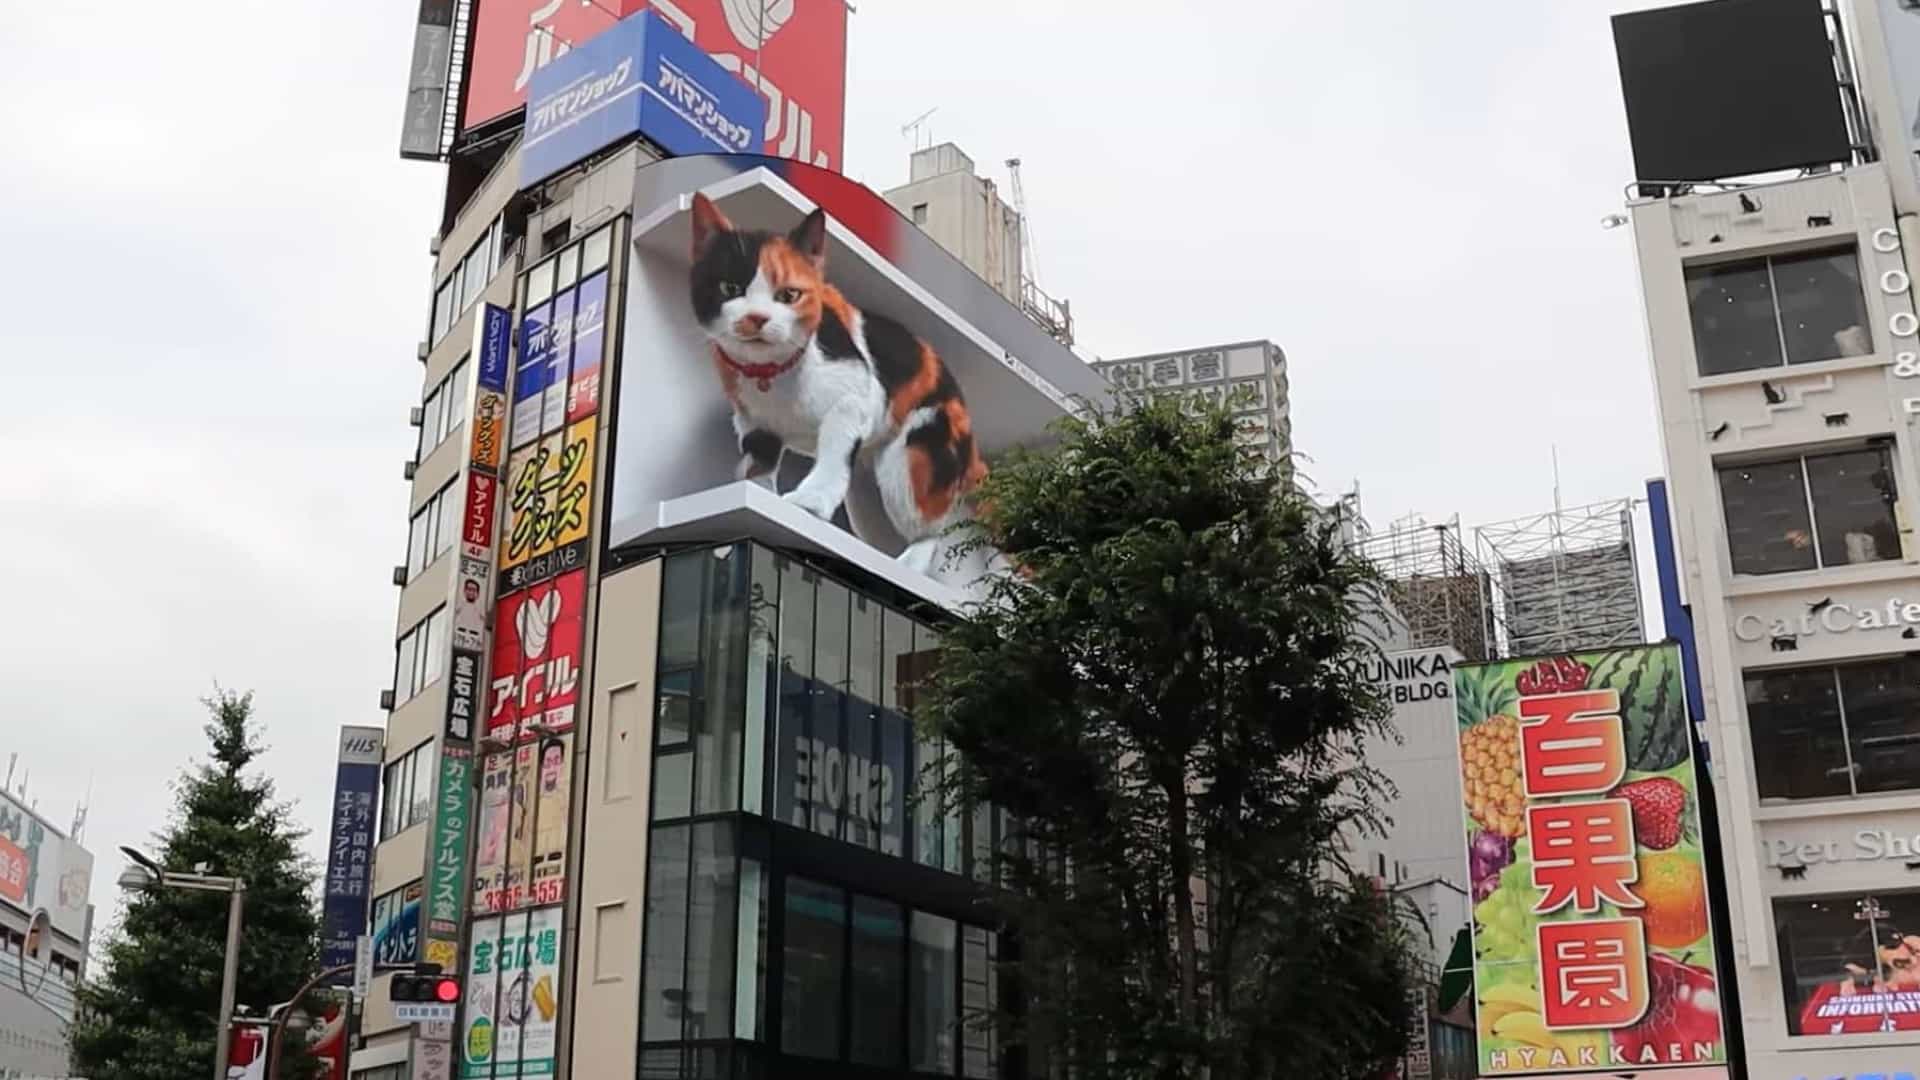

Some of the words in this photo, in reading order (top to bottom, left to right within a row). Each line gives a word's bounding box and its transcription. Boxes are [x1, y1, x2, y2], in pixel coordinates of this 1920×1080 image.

[532, 57, 633, 132] アパマンショップ
[657, 64, 752, 147] アパマンショップ
[511, 437, 587, 512] ダーツ
[471, 491, 486, 543] アイフル
[508, 481, 587, 560] グッズ
[450, 656, 474, 739] 宝石広場
[1364, 653, 1450, 682] UNIKA
[433, 760, 466, 920] カメラのアルプス堂
[1518, 689, 1651, 1032] 百果園
[1762, 836, 1839, 868] Pet
[472, 929, 557, 975] 宝石広場
[1818, 1000, 1920, 1017] INFORMAT
[1491, 1042, 1714, 1069] HYAKKAEN
